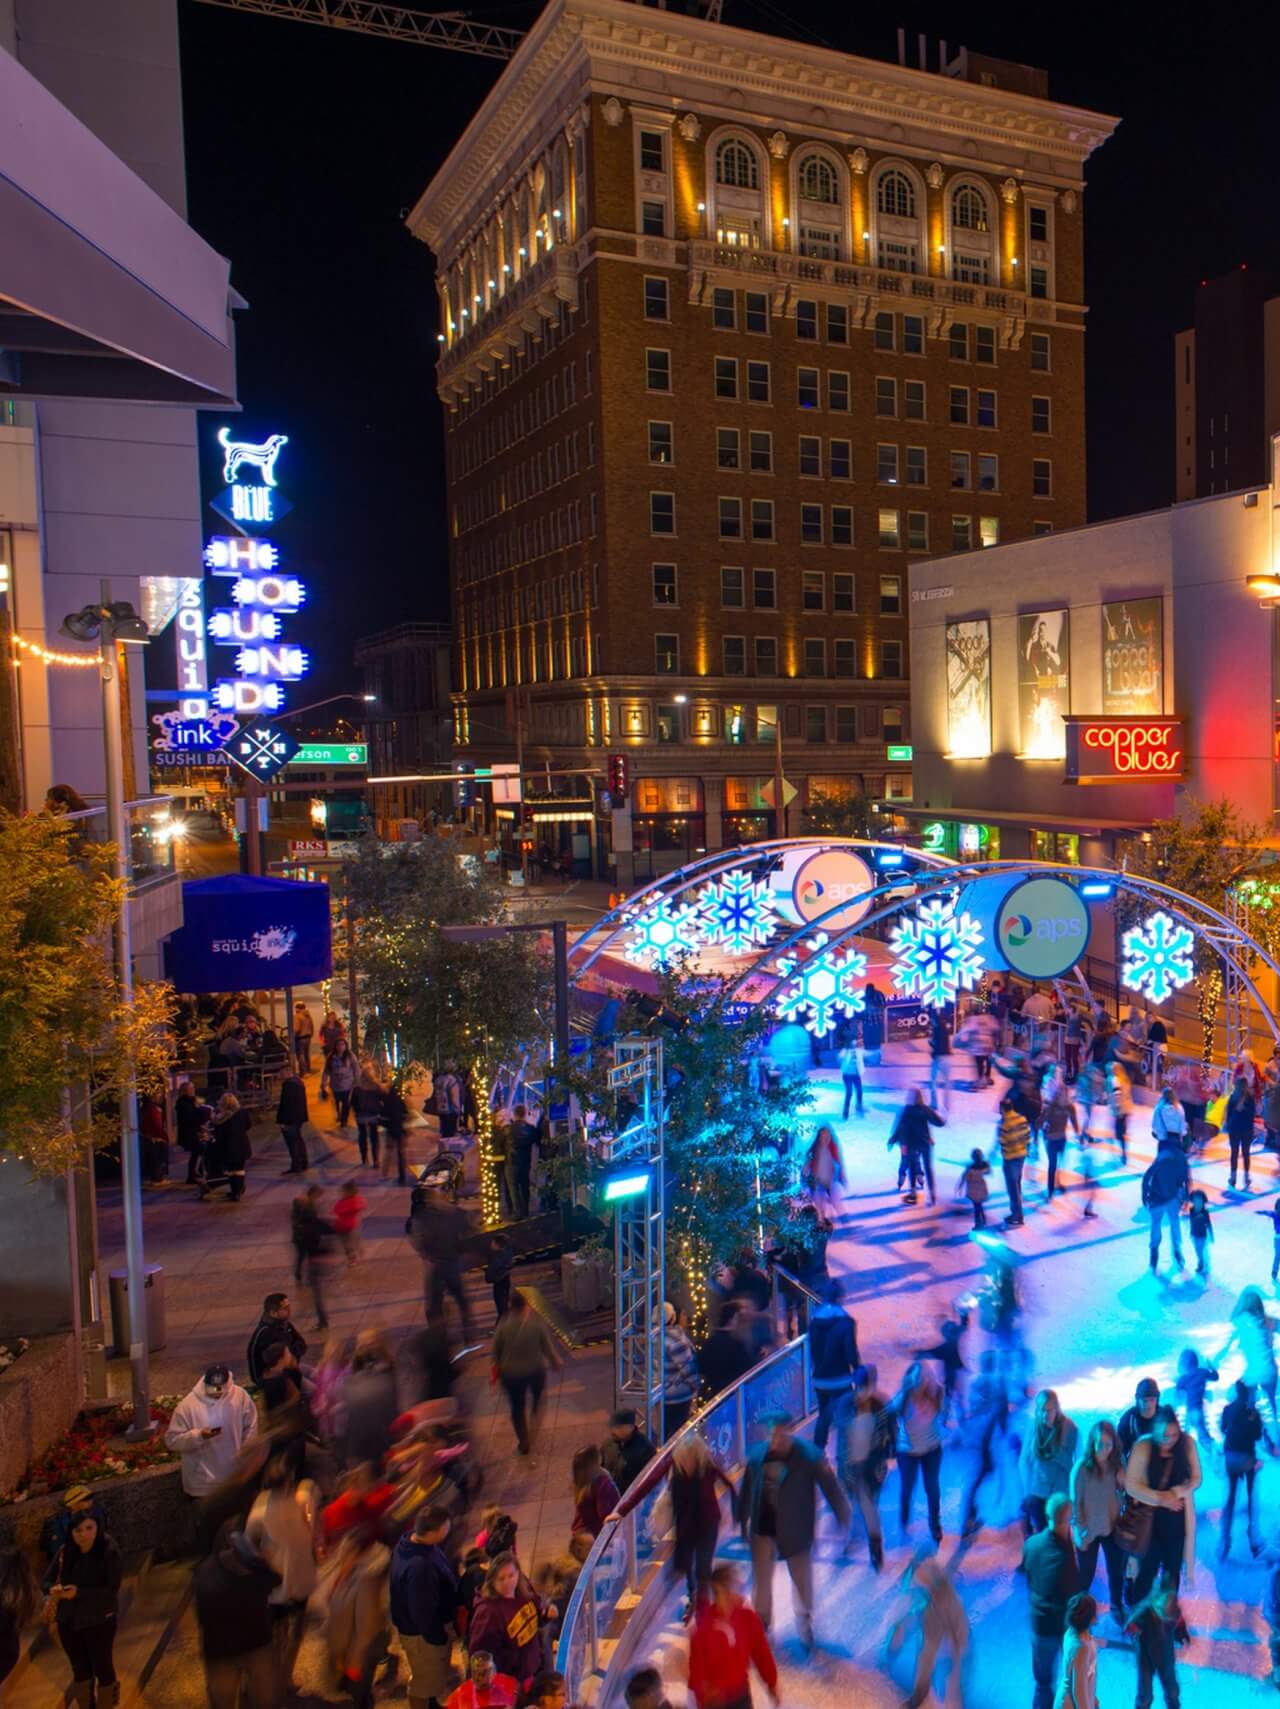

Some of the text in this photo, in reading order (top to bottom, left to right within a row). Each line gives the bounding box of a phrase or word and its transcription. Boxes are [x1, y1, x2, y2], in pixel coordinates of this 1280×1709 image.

[230, 484, 273, 522] BLUE
[177, 724, 213, 745] ink
[1085, 727, 1172, 748] copper
[156, 752, 202, 766] SUSHI
[294, 750, 331, 759] erson
[1115, 751, 1180, 772] blues
[295, 840, 325, 850] RKS
[828, 880, 868, 902] aps
[1036, 916, 1082, 944] aps
[212, 939, 258, 954] squid
